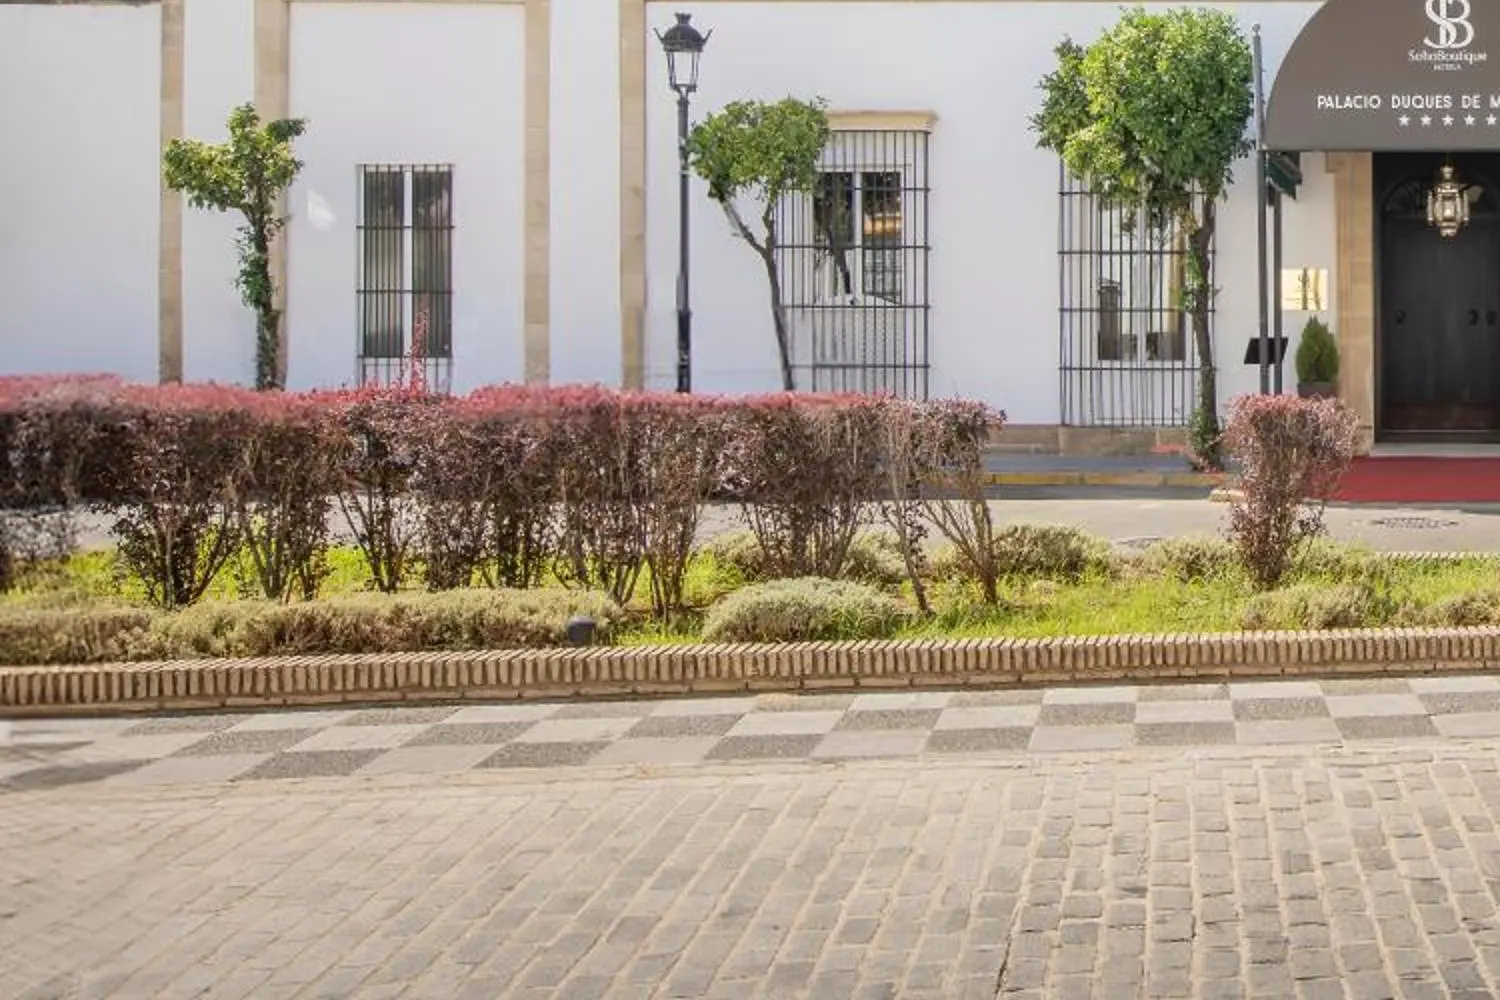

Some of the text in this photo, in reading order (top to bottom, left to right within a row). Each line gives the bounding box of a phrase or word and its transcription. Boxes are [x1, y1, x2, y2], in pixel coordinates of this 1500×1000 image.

[1317, 95, 1381, 109] PALACIO
[1391, 95, 1453, 109] DUQUES
[1461, 95, 1481, 109] DE
